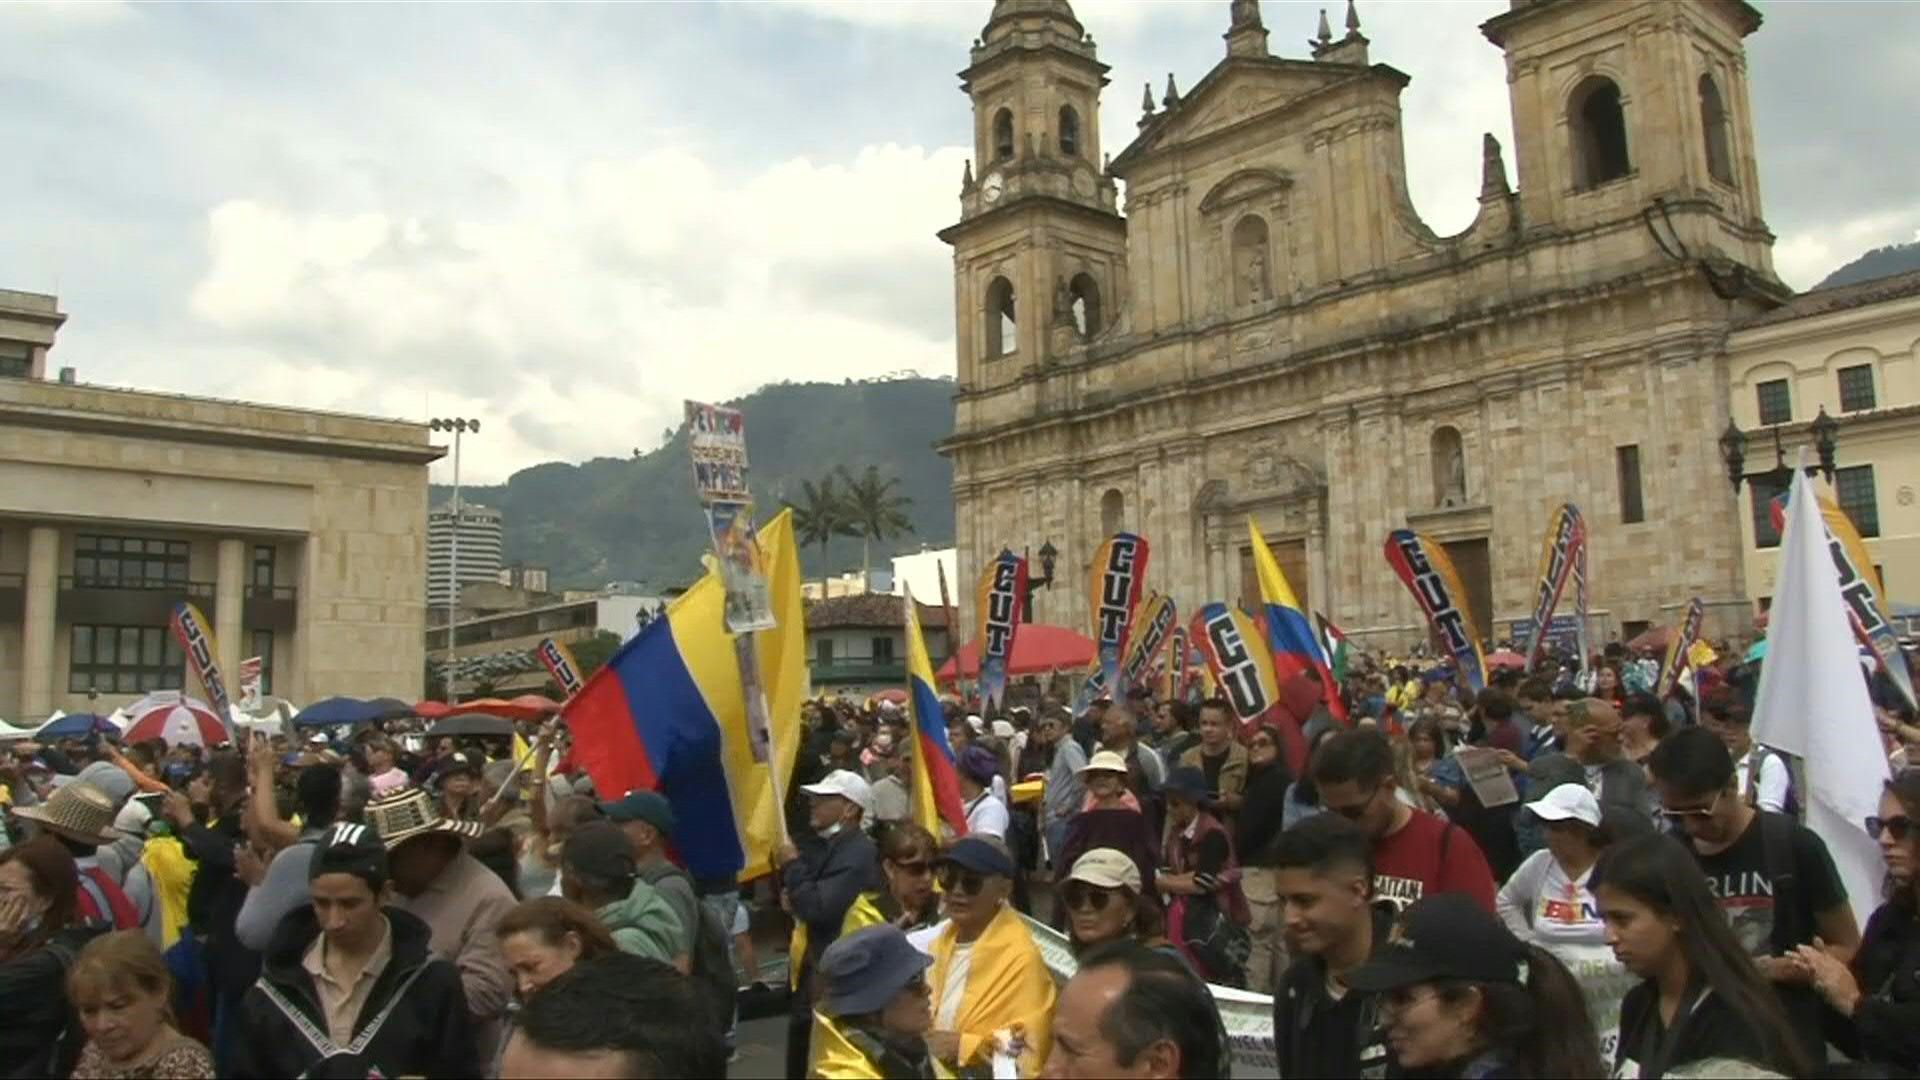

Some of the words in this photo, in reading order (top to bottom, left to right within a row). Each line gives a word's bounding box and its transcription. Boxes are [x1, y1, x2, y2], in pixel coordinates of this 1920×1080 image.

[984, 561, 1018, 656] CUT
[1099, 538, 1136, 642] CUT
[1397, 540, 1471, 652] CUT
[1127, 600, 1174, 680] CUT
